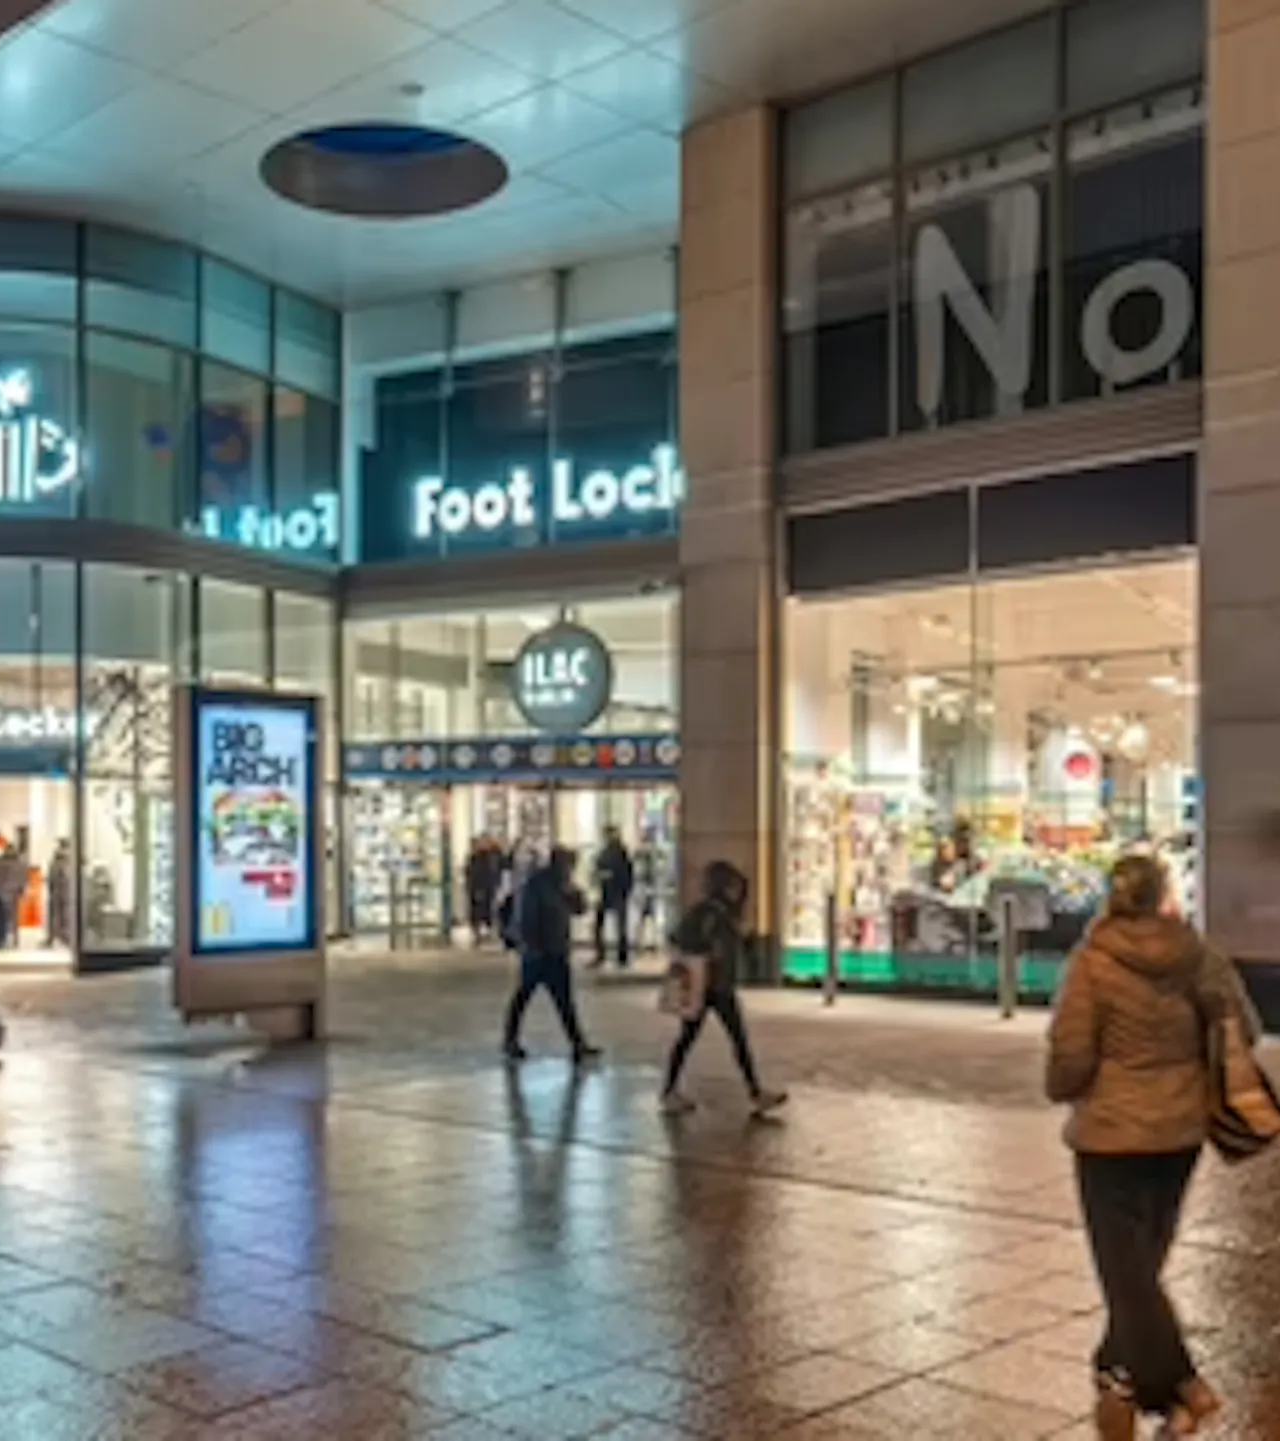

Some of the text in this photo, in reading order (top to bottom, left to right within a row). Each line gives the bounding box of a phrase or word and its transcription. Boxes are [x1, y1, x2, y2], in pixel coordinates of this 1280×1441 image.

[412, 468, 536, 540] Foot
[523, 648, 590, 686] ILAC
[213, 721, 264, 751] BIG
[207, 756, 296, 786] ARCH
